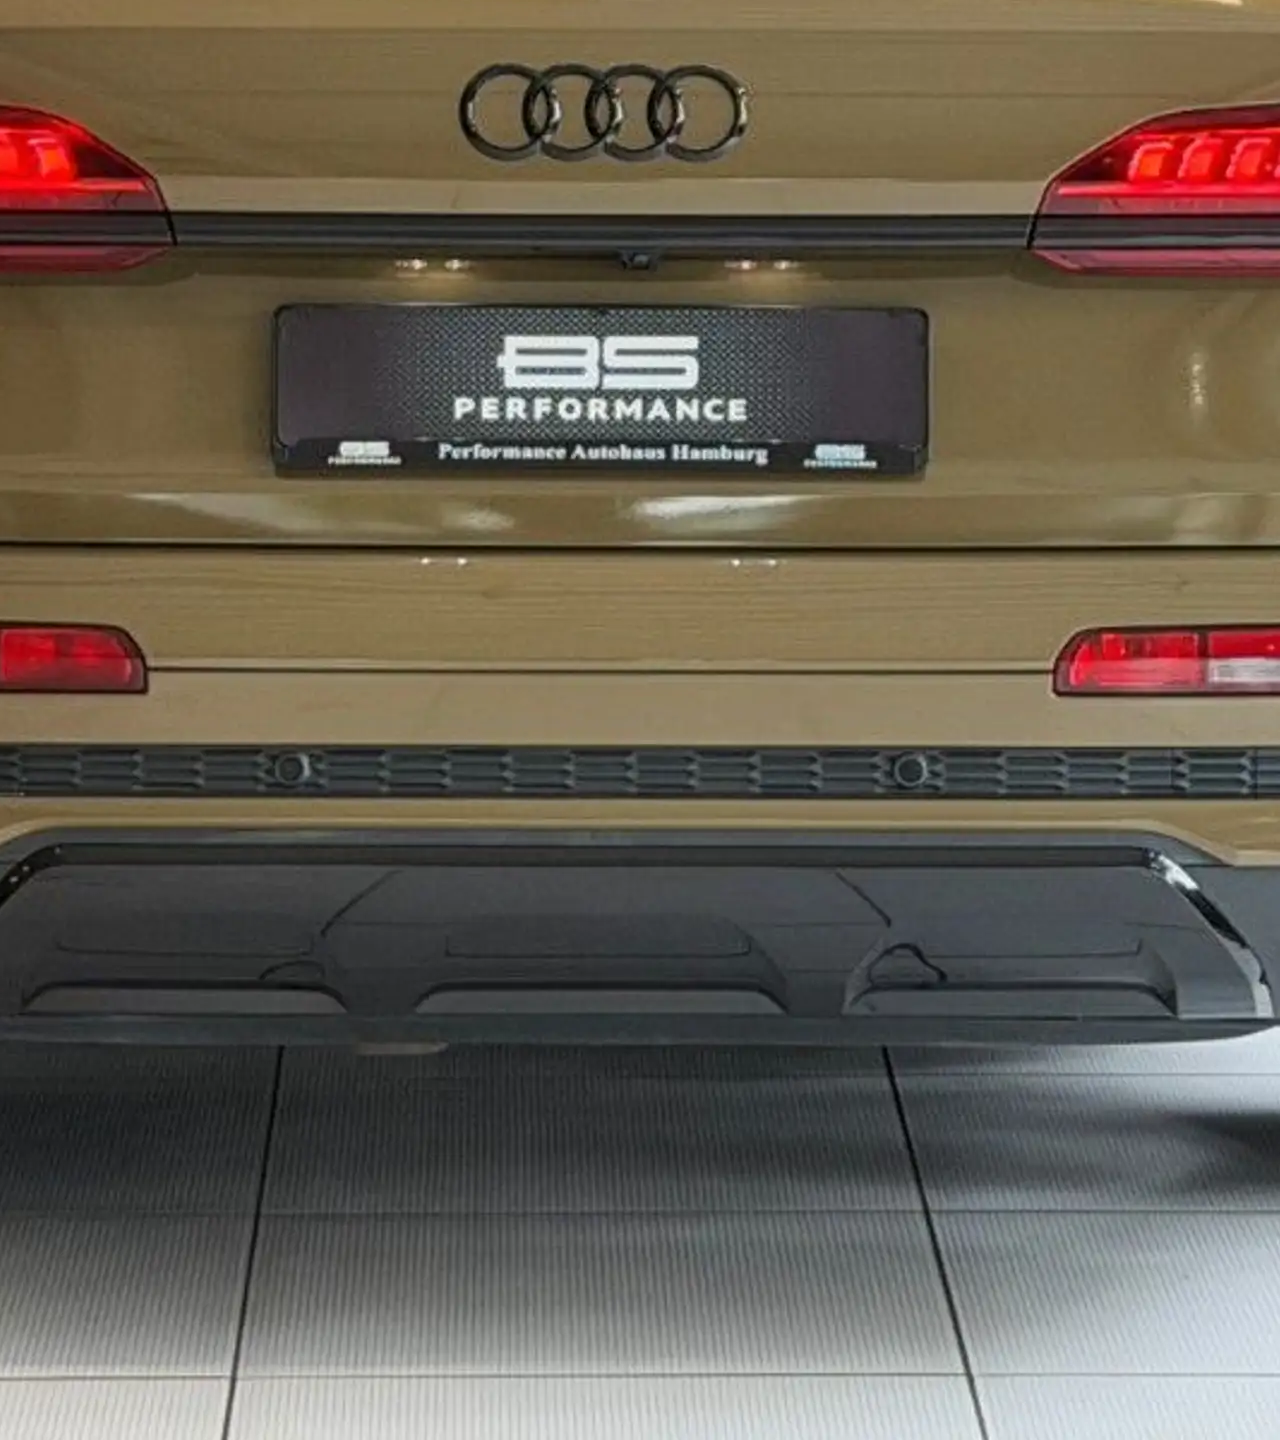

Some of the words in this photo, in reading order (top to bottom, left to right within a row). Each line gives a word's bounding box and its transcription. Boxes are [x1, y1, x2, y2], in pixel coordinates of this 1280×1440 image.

[497, 335, 699, 390] BS
[453, 396, 748, 423] PERFORMANCE
[437, 442, 567, 461] Performance
[570, 443, 667, 461] Autohaus
[671, 444, 769, 466] Hamburg
